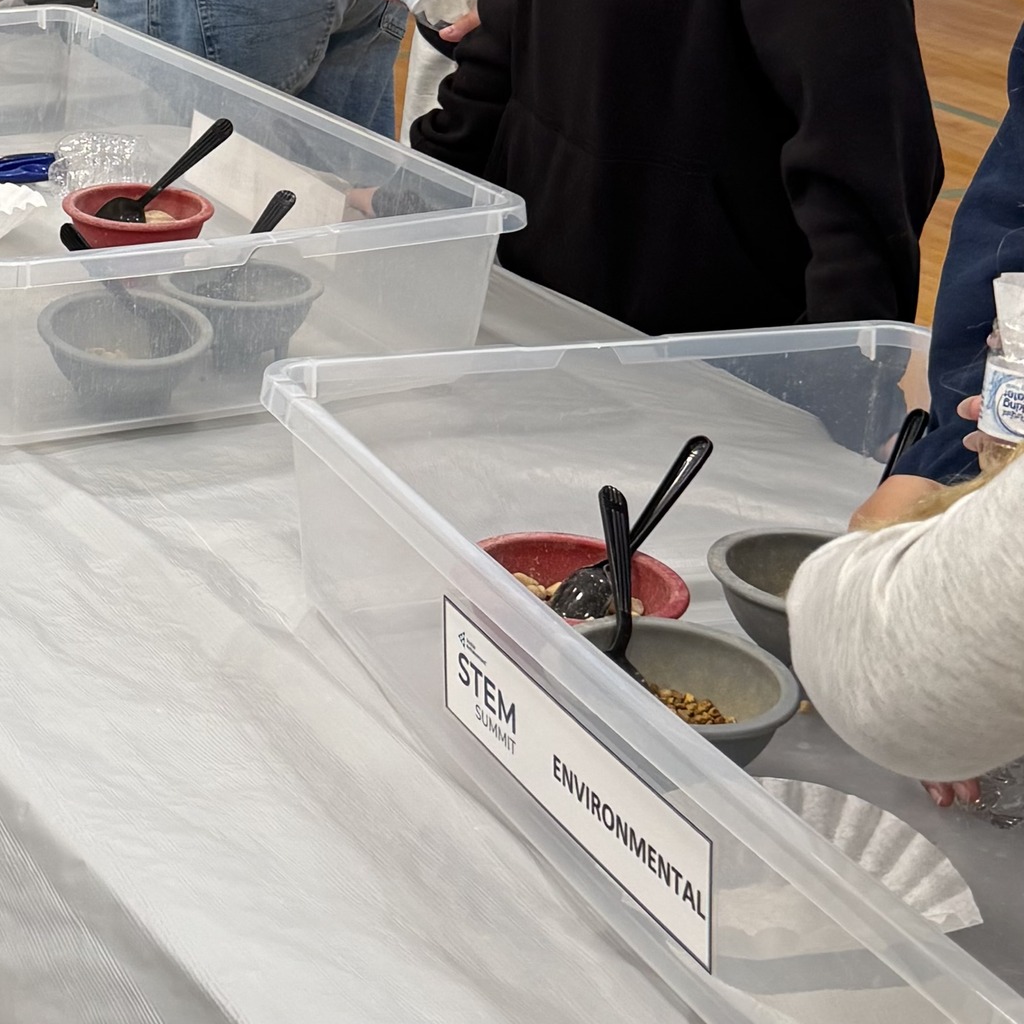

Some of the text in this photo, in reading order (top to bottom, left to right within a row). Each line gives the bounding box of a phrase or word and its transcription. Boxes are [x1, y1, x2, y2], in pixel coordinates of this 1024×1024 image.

[458, 652, 517, 735] STEM
[475, 704, 517, 755] SUMMIT
[552, 754, 707, 922] ENVIRONMENTAL
